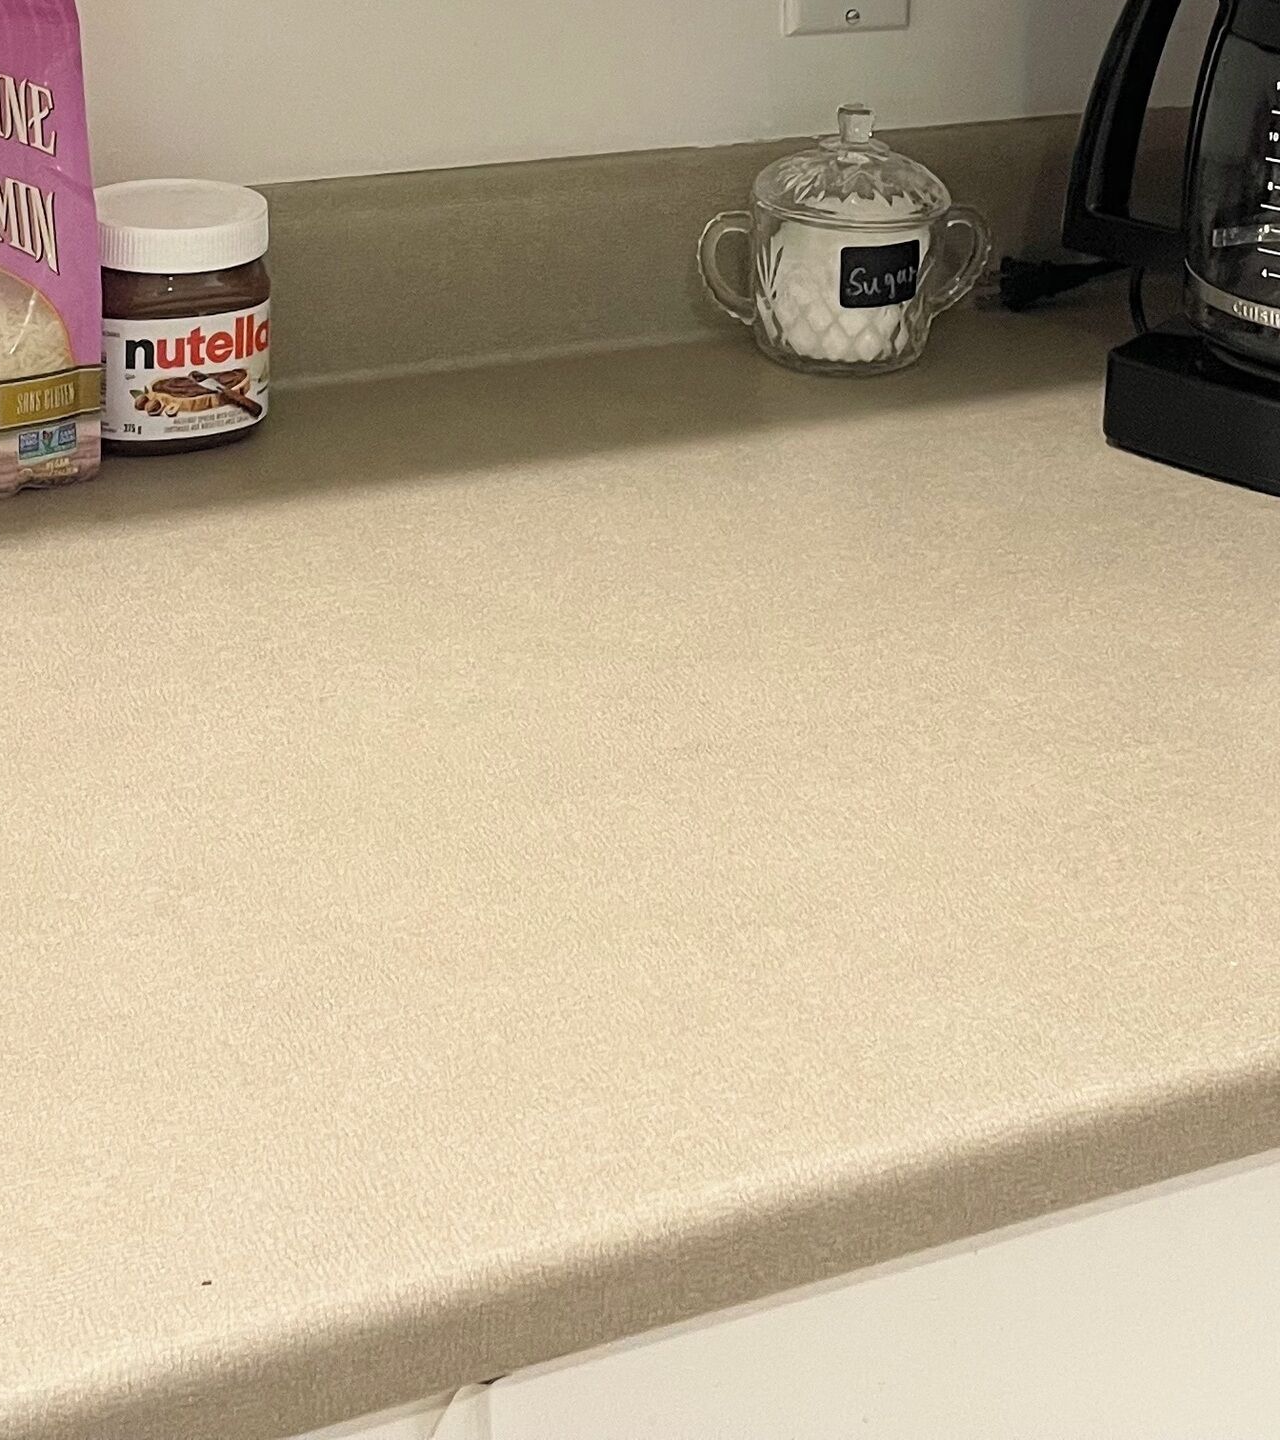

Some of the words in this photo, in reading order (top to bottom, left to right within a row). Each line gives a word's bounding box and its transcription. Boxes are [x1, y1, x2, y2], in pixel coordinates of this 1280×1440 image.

[1268, 131, 1280, 142] 10
[845, 265, 917, 300] Sugar
[125, 314, 270, 369] nutella
